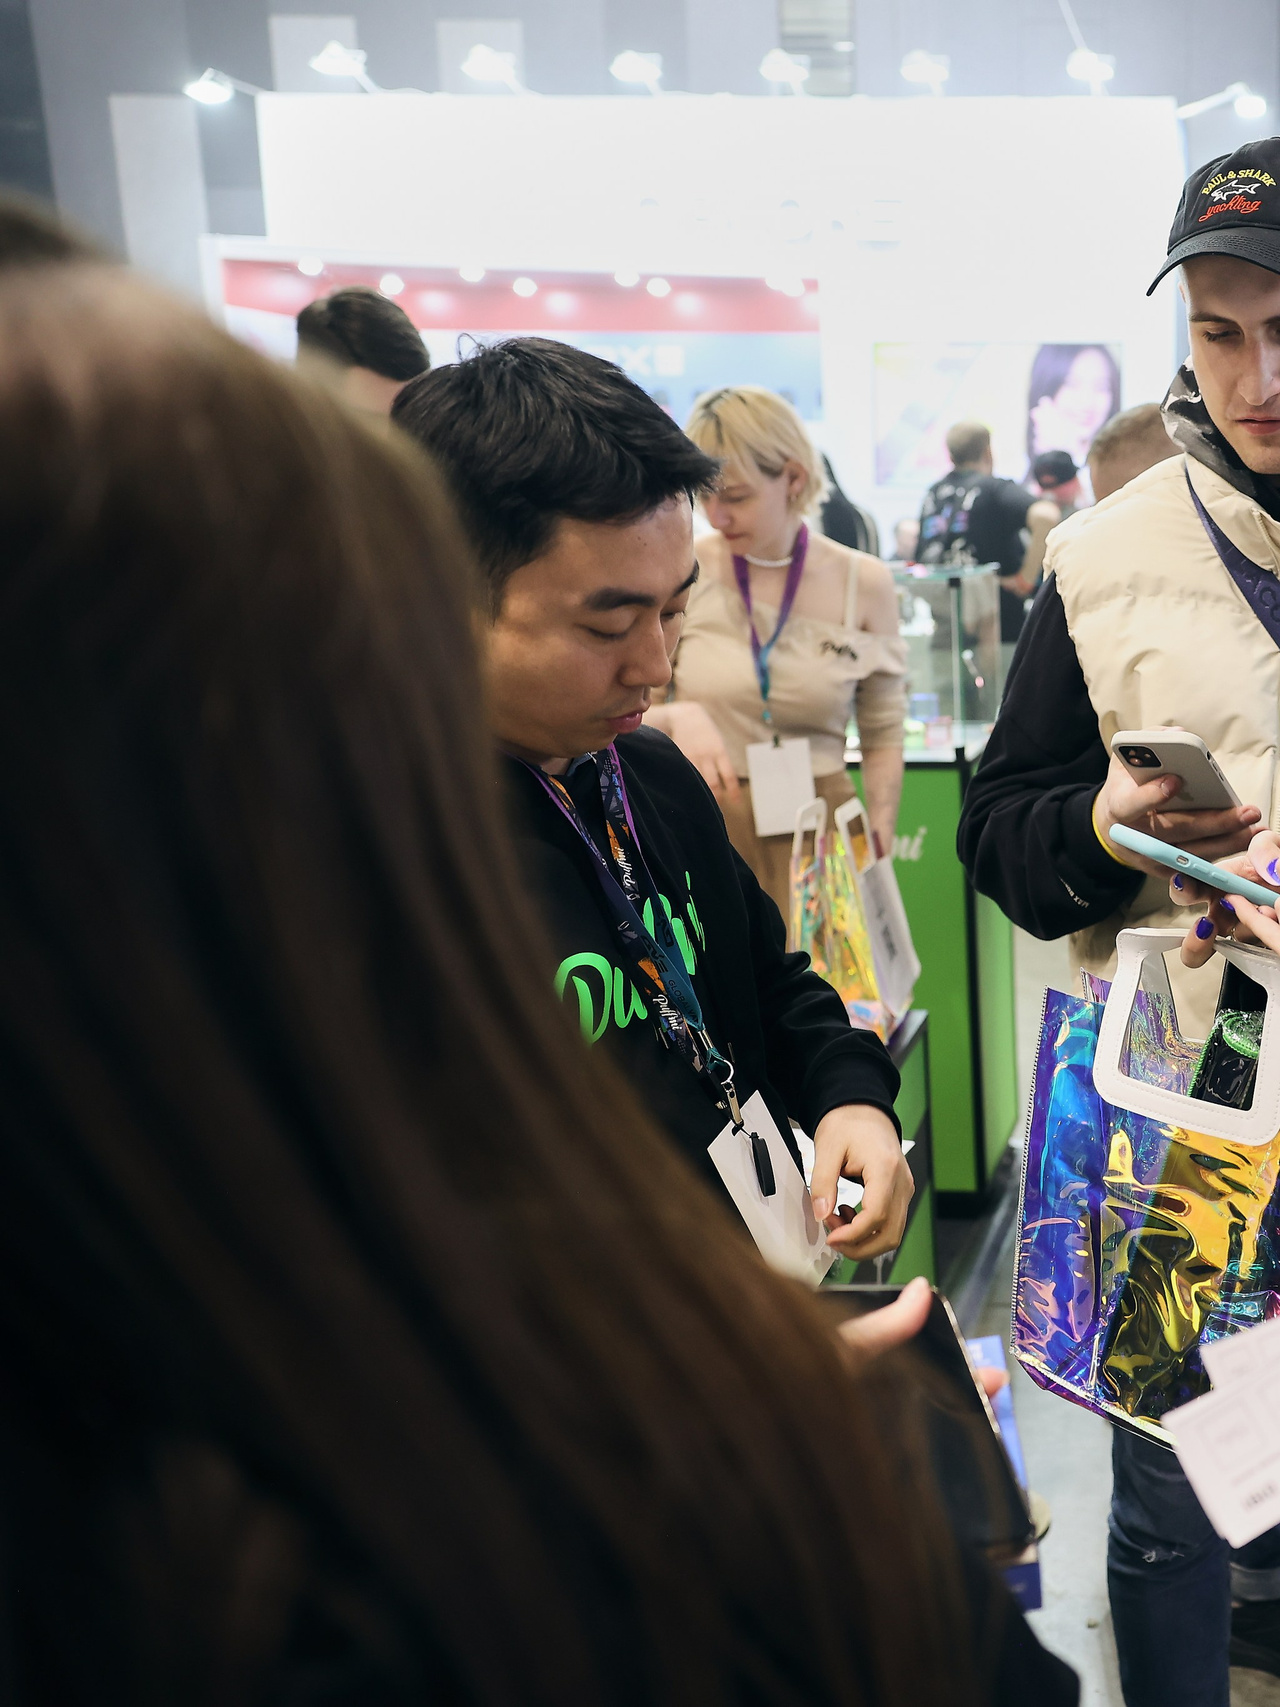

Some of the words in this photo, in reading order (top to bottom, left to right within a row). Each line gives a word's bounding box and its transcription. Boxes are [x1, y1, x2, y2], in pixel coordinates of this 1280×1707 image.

[1201, 173, 1227, 195] PAUL
[1227, 170, 1237, 179] &
[1237, 169, 1276, 187] SHARK
[1198, 194, 1262, 222] yachting
[652, 994, 683, 1031] Puffmi
